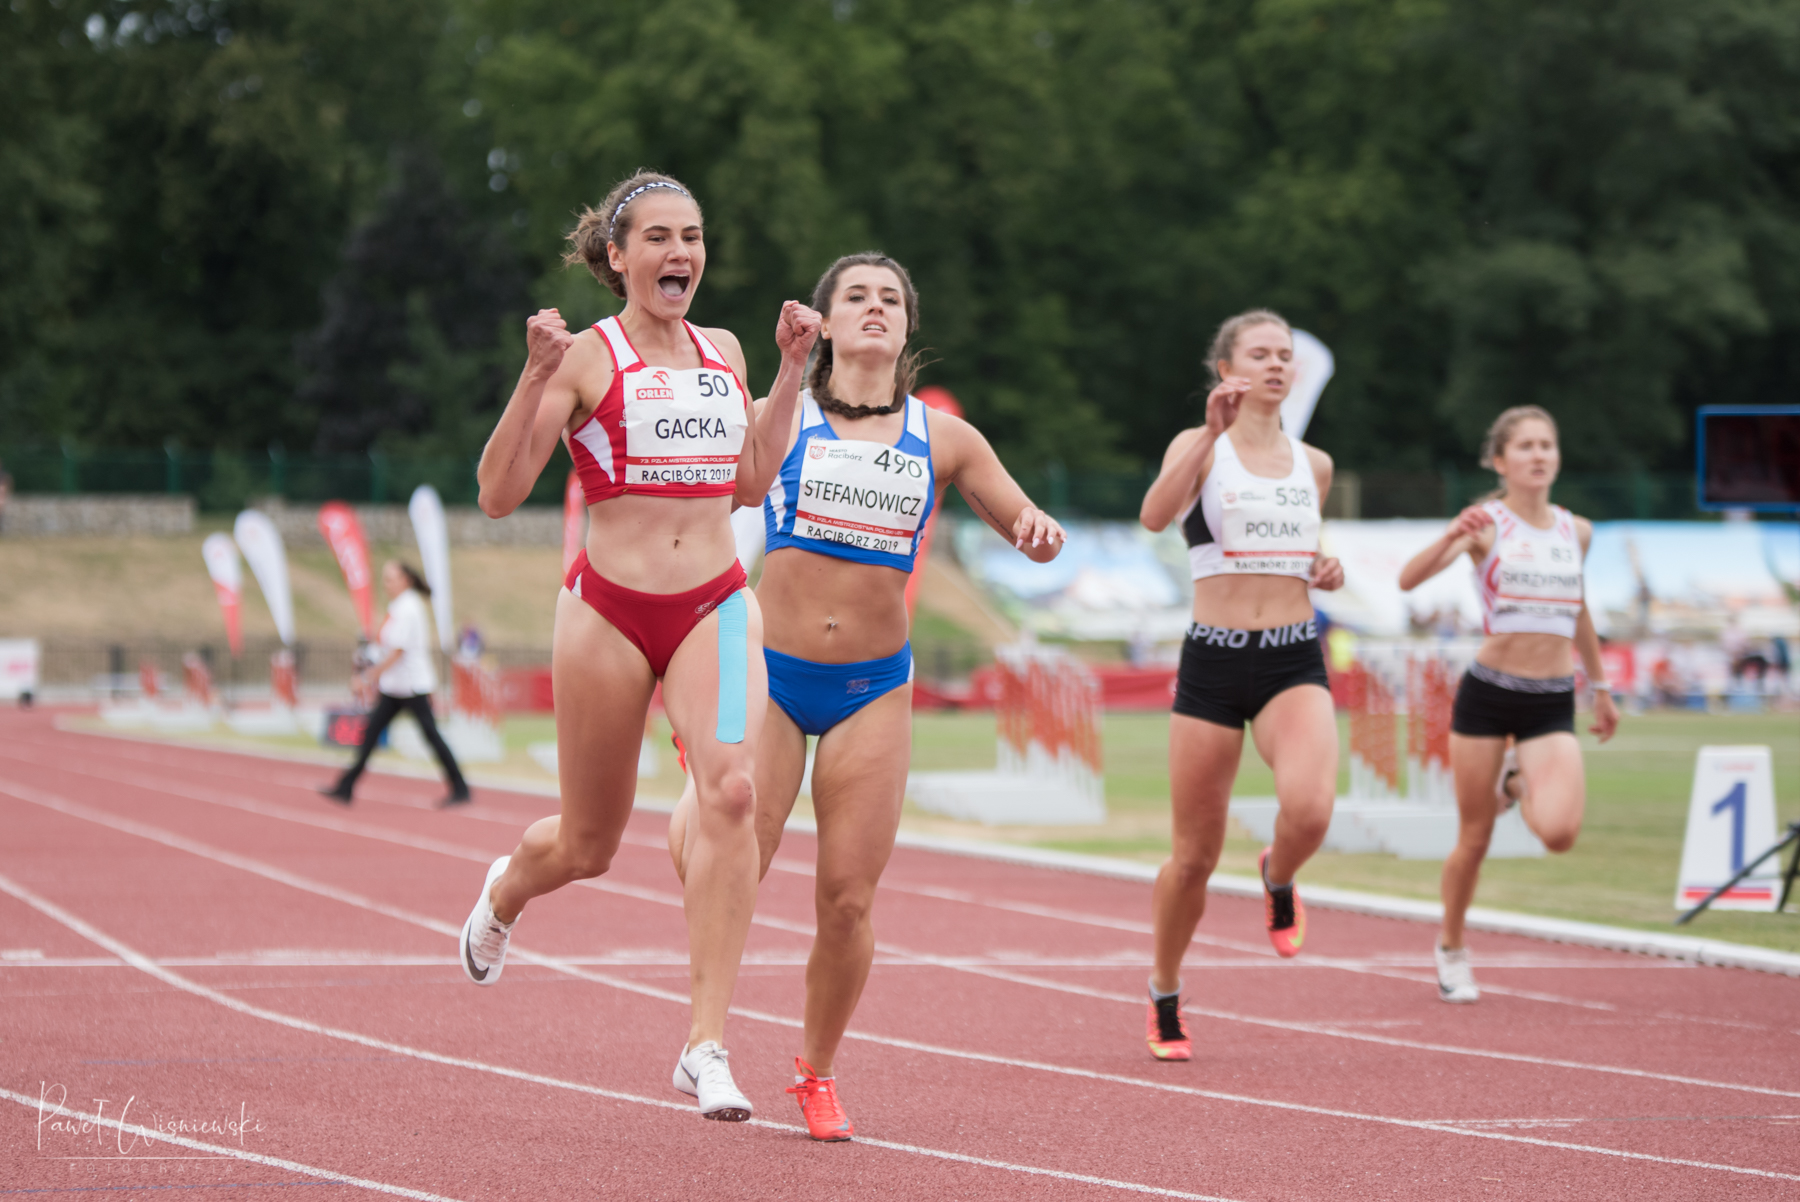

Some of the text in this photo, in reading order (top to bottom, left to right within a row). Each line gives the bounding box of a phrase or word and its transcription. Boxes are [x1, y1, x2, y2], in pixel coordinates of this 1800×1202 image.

[637, 389, 673, 399] ORLEN
[698, 374, 729, 397] 50
[655, 418, 727, 439] GACKA
[642, 466, 731, 482] RACIBÓRZ 2019
[874, 449, 922, 478] 490
[804, 479, 921, 516] STEFANOWICZ
[1275, 488, 1311, 507] 538
[833, 520, 873, 532] MISTRZOSTWA
[1245, 522, 1301, 538] POLAK
[807, 525, 899, 551] RACIBÓRZ 2019
[1234, 558, 1287, 570] RACIBÓRZ
[1192, 618, 1318, 649] PRO NIKE
[1711, 781, 1747, 876] 1
